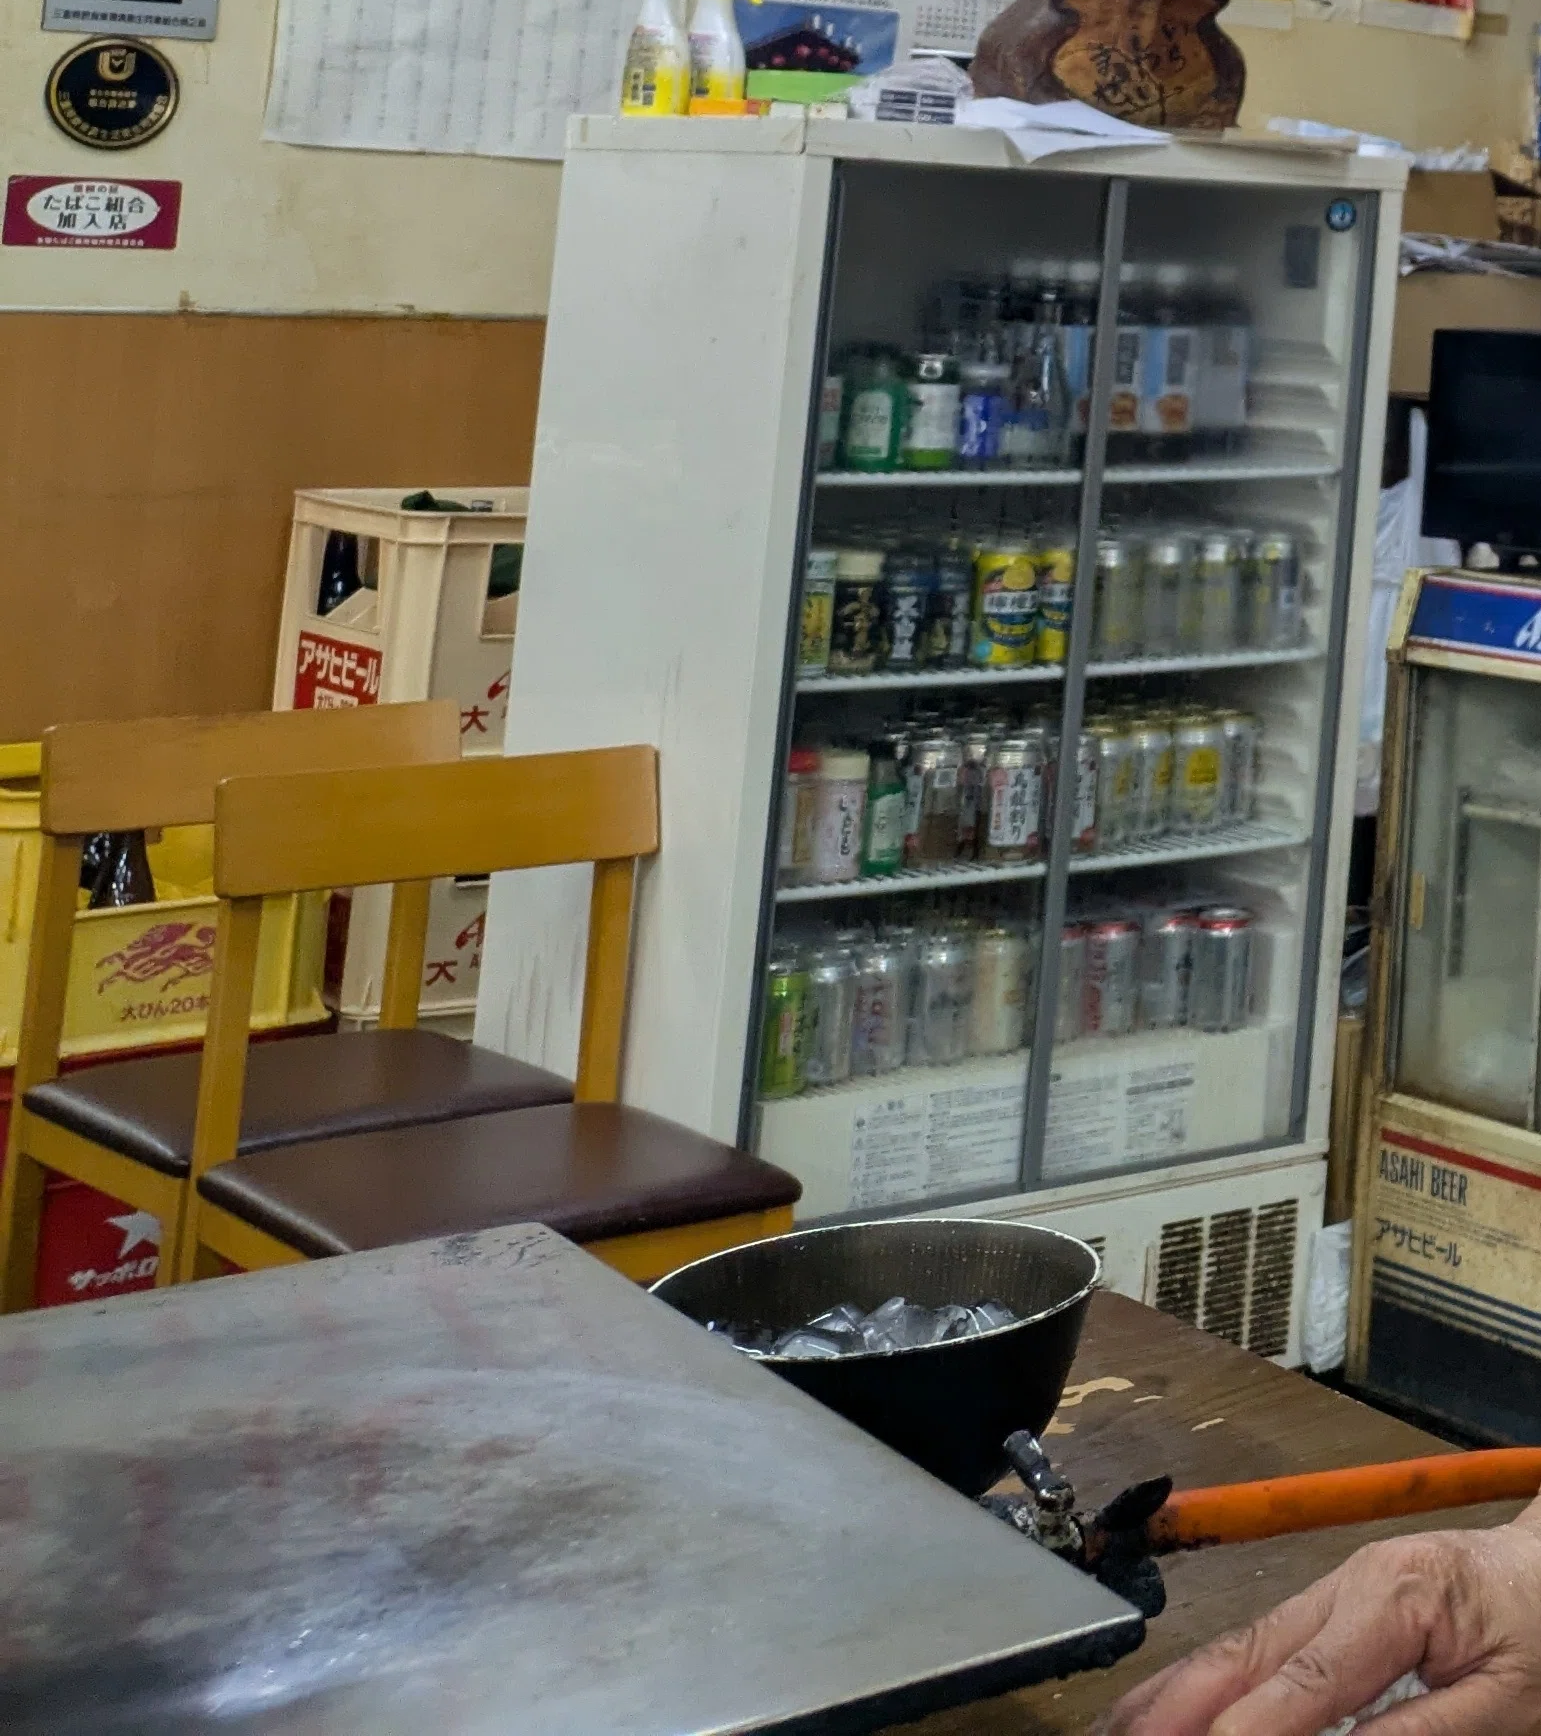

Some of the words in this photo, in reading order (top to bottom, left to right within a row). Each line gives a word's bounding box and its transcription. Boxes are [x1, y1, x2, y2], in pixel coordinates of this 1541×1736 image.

[43, 195, 146, 214] たばこ組合
[57, 214, 127, 230] 加入店
[300, 639, 380, 695] アサヒビール
[1380, 1149, 1425, 1192] ASAHI
[1431, 1165, 1468, 1206] BEER
[1374, 1217, 1462, 1268] アサヒビール
